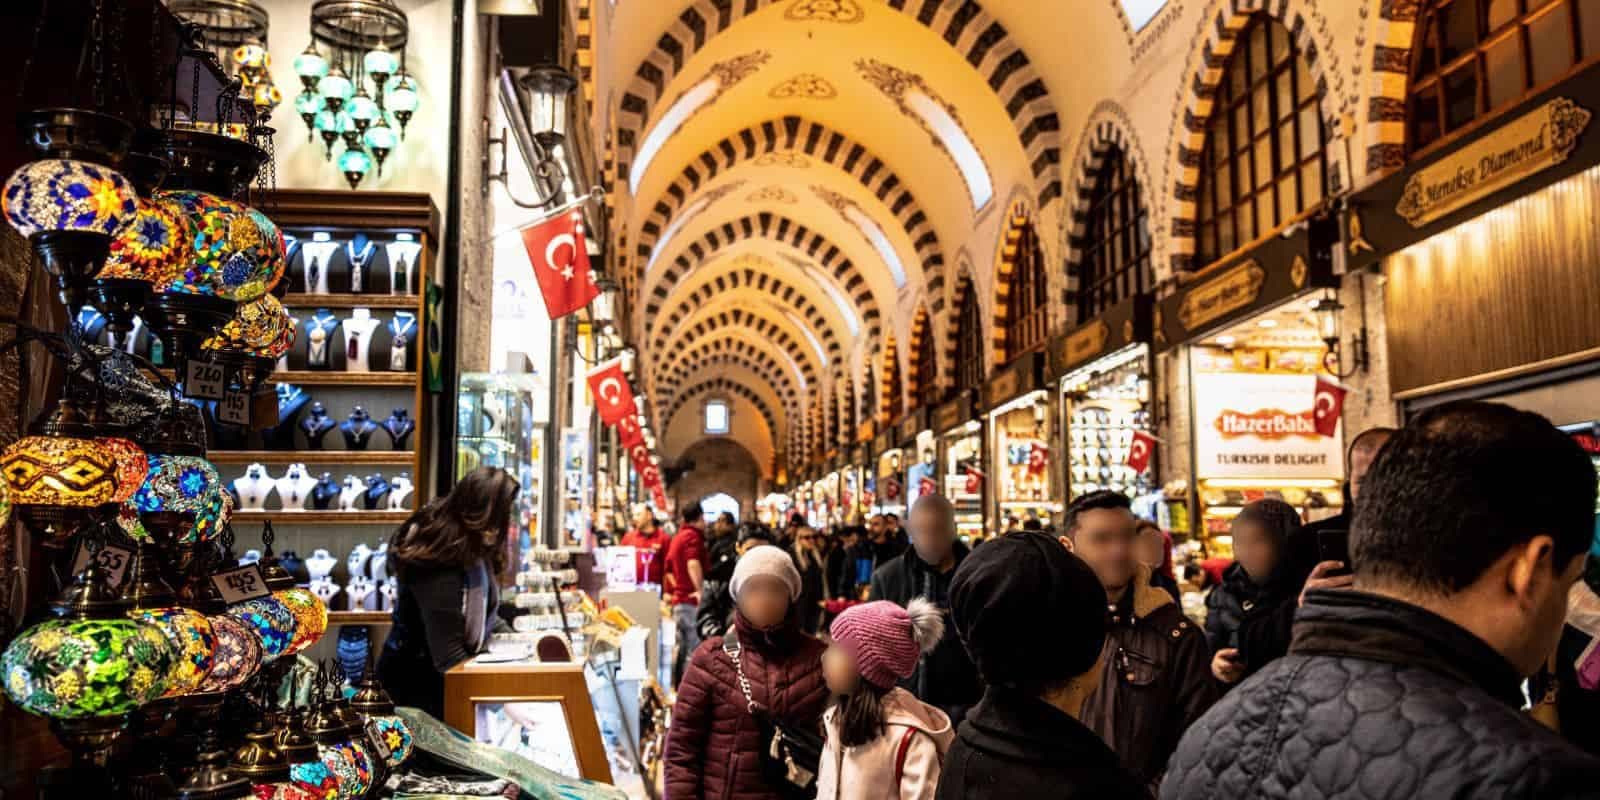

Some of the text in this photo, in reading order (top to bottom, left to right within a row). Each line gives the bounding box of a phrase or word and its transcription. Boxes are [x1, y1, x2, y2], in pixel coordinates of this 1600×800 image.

[1478, 122, 1548, 181] Diamond
[200, 384, 217, 394] TL
[1217, 453, 1327, 465] TURKISH DELIGHT
